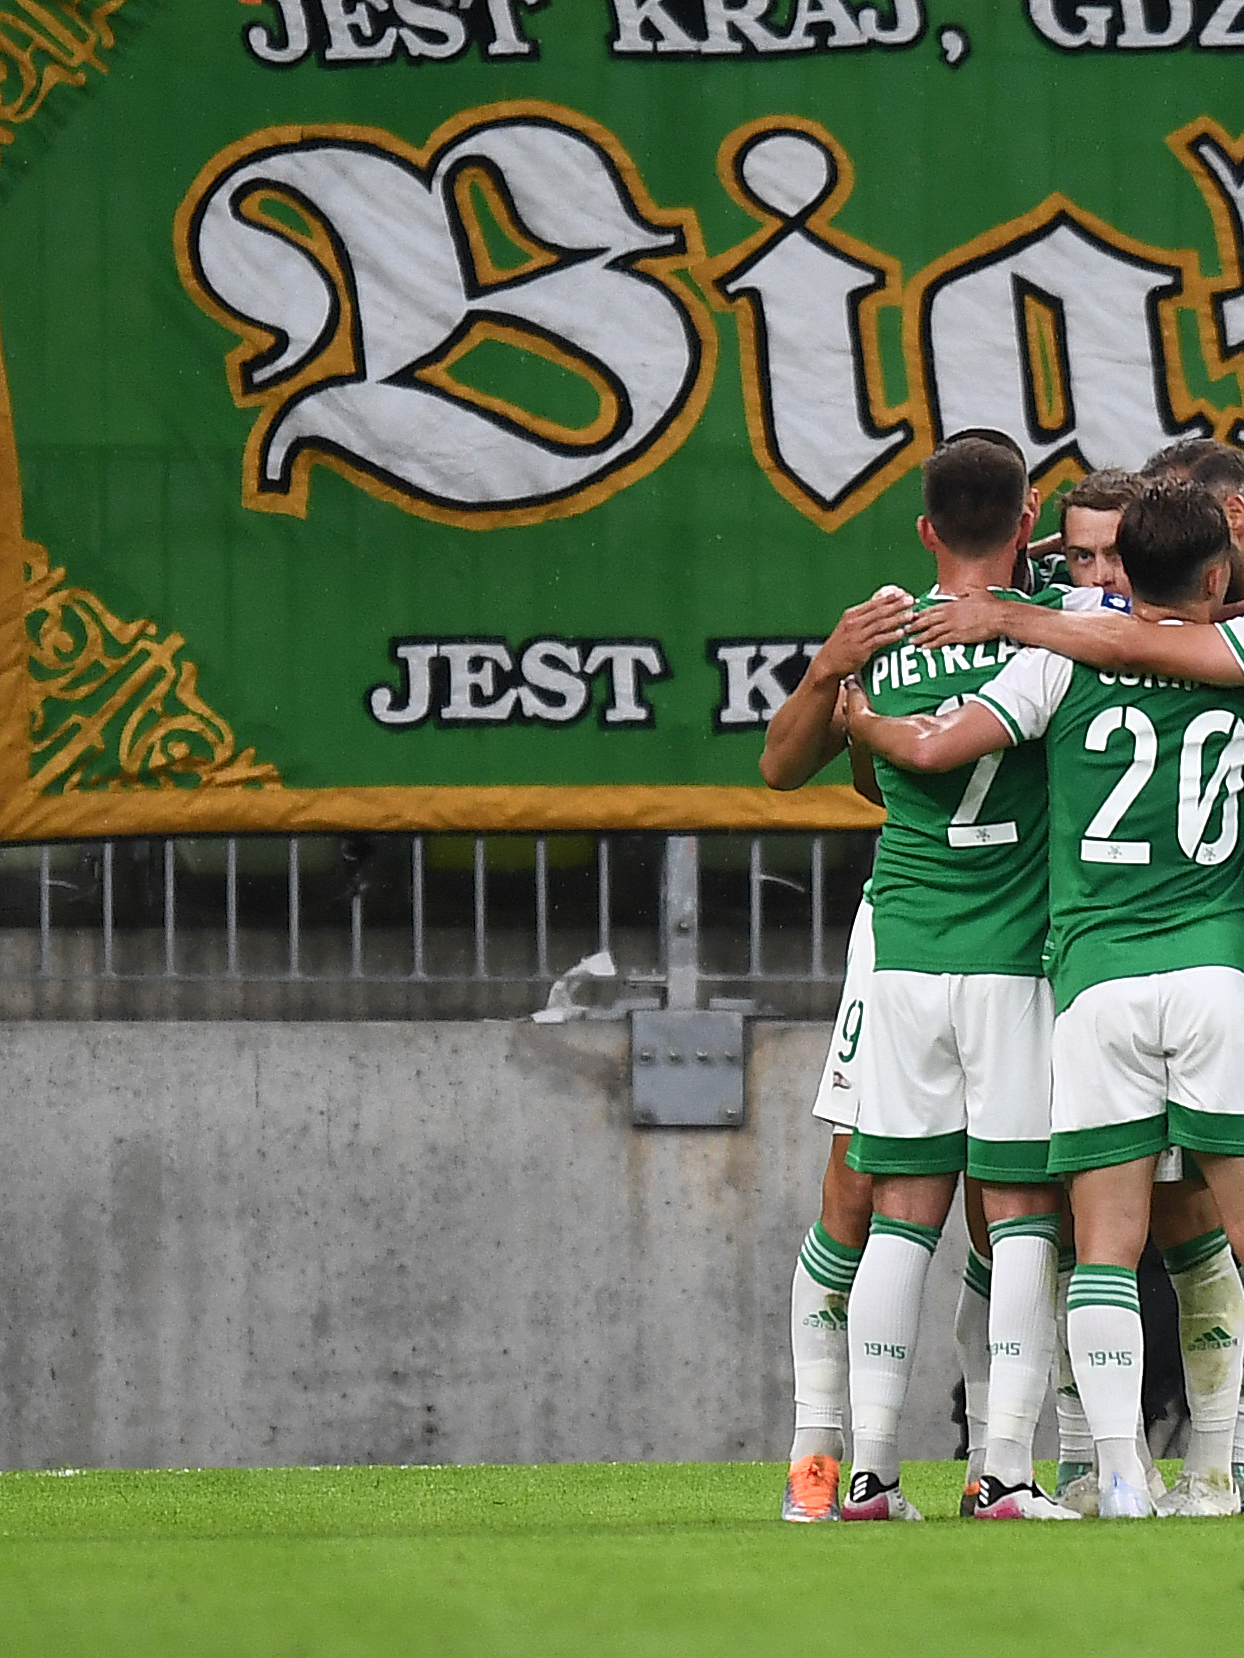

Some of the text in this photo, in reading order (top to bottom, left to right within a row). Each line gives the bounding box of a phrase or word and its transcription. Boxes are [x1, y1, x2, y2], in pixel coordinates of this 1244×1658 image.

[249, 0, 537, 62] JEST
[371, 641, 661, 724] JEST
[872, 636, 1019, 696] PIETRZA
[837, 999, 865, 1064] 9
[864, 1341, 907, 1361] 1945
[1087, 1351, 1133, 1368] 1945
